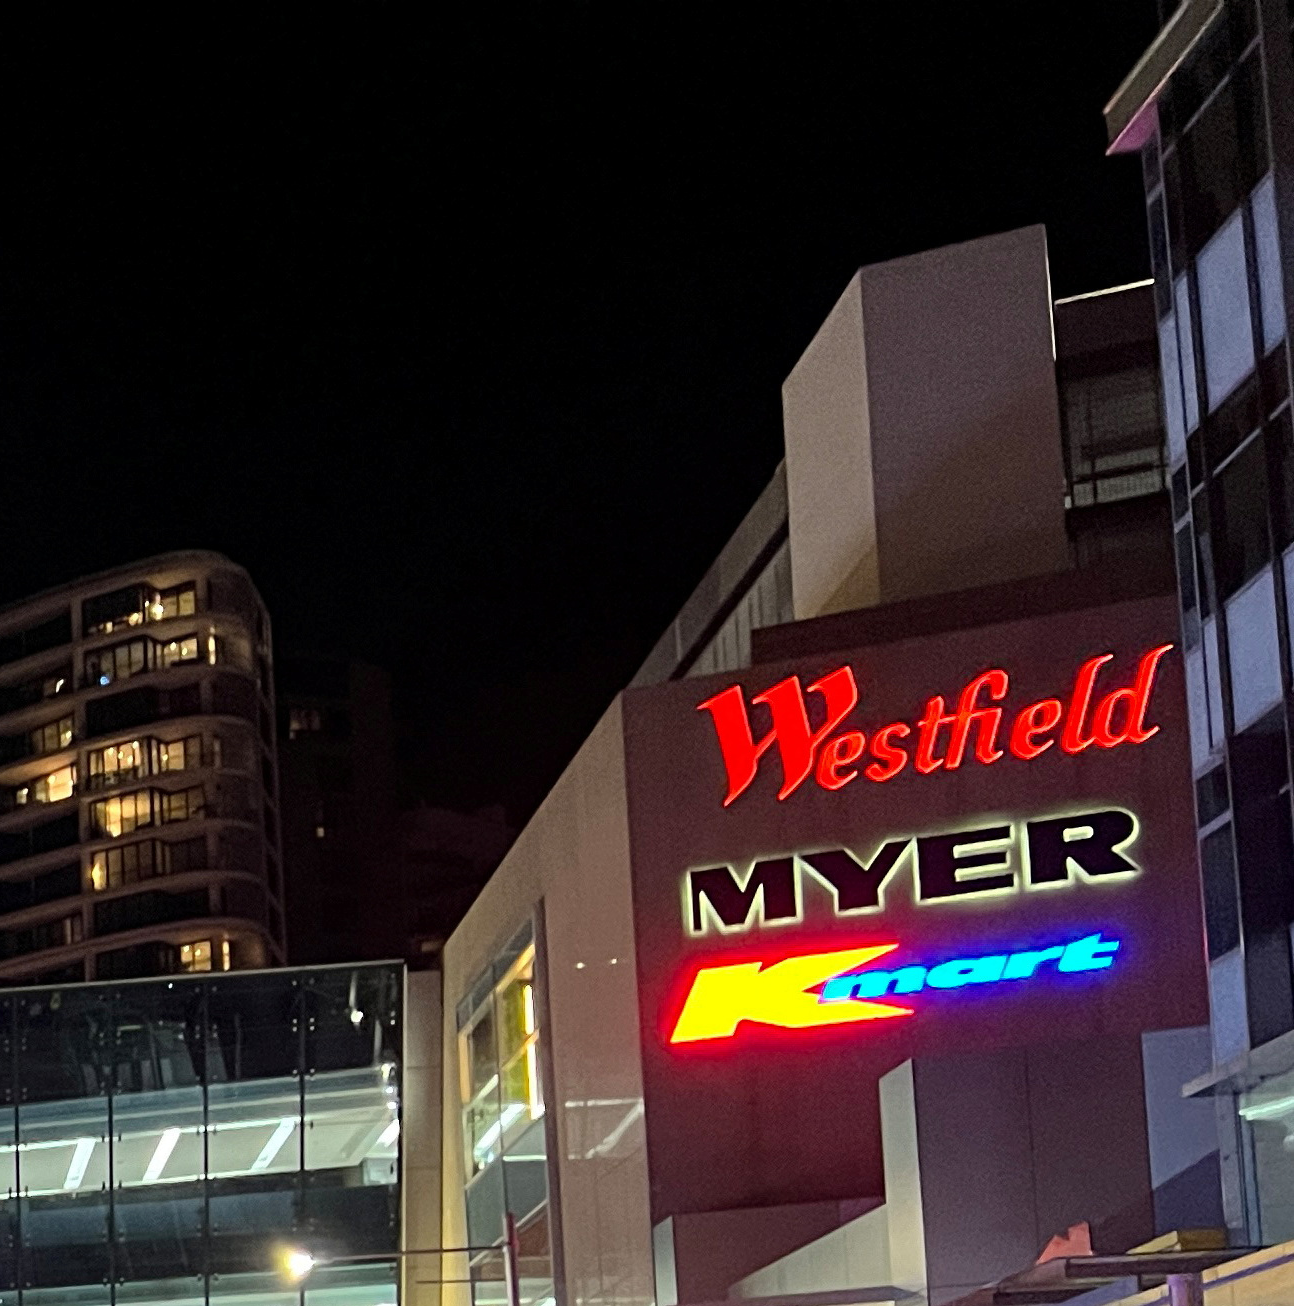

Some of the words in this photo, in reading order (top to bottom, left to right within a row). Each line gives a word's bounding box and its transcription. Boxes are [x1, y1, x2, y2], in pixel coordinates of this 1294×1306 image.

[697, 644, 1174, 807] Westfield
[684, 808, 1142, 936] MYER
[669, 932, 1119, 1044] Kmart
